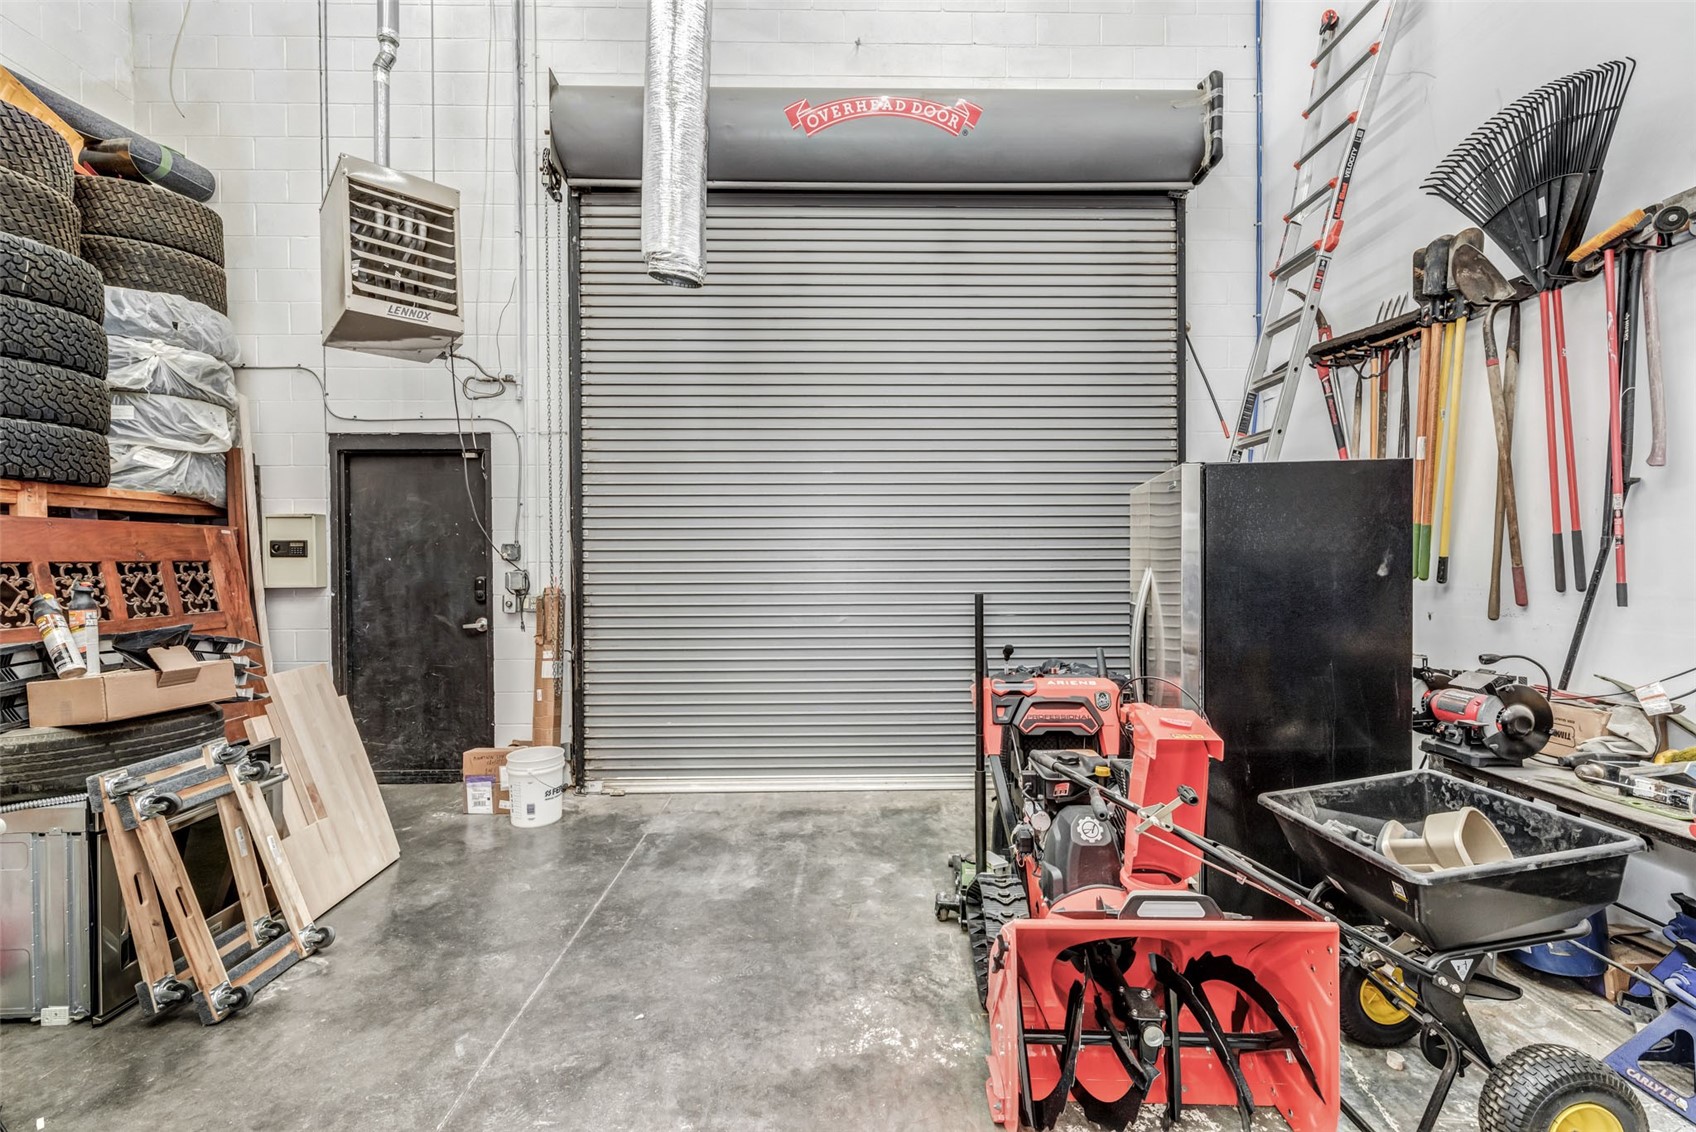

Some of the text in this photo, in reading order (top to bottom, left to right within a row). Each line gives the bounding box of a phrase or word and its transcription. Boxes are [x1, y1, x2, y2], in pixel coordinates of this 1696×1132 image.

[806, 98, 960, 130] OVERHEAD DOOR
[1333, 200, 1344, 218] Little
[1344, 147, 1358, 178] VELOCITY
[387, 304, 432, 321] LENNOX
[1626, 1068, 1677, 1103] CARLYLE
